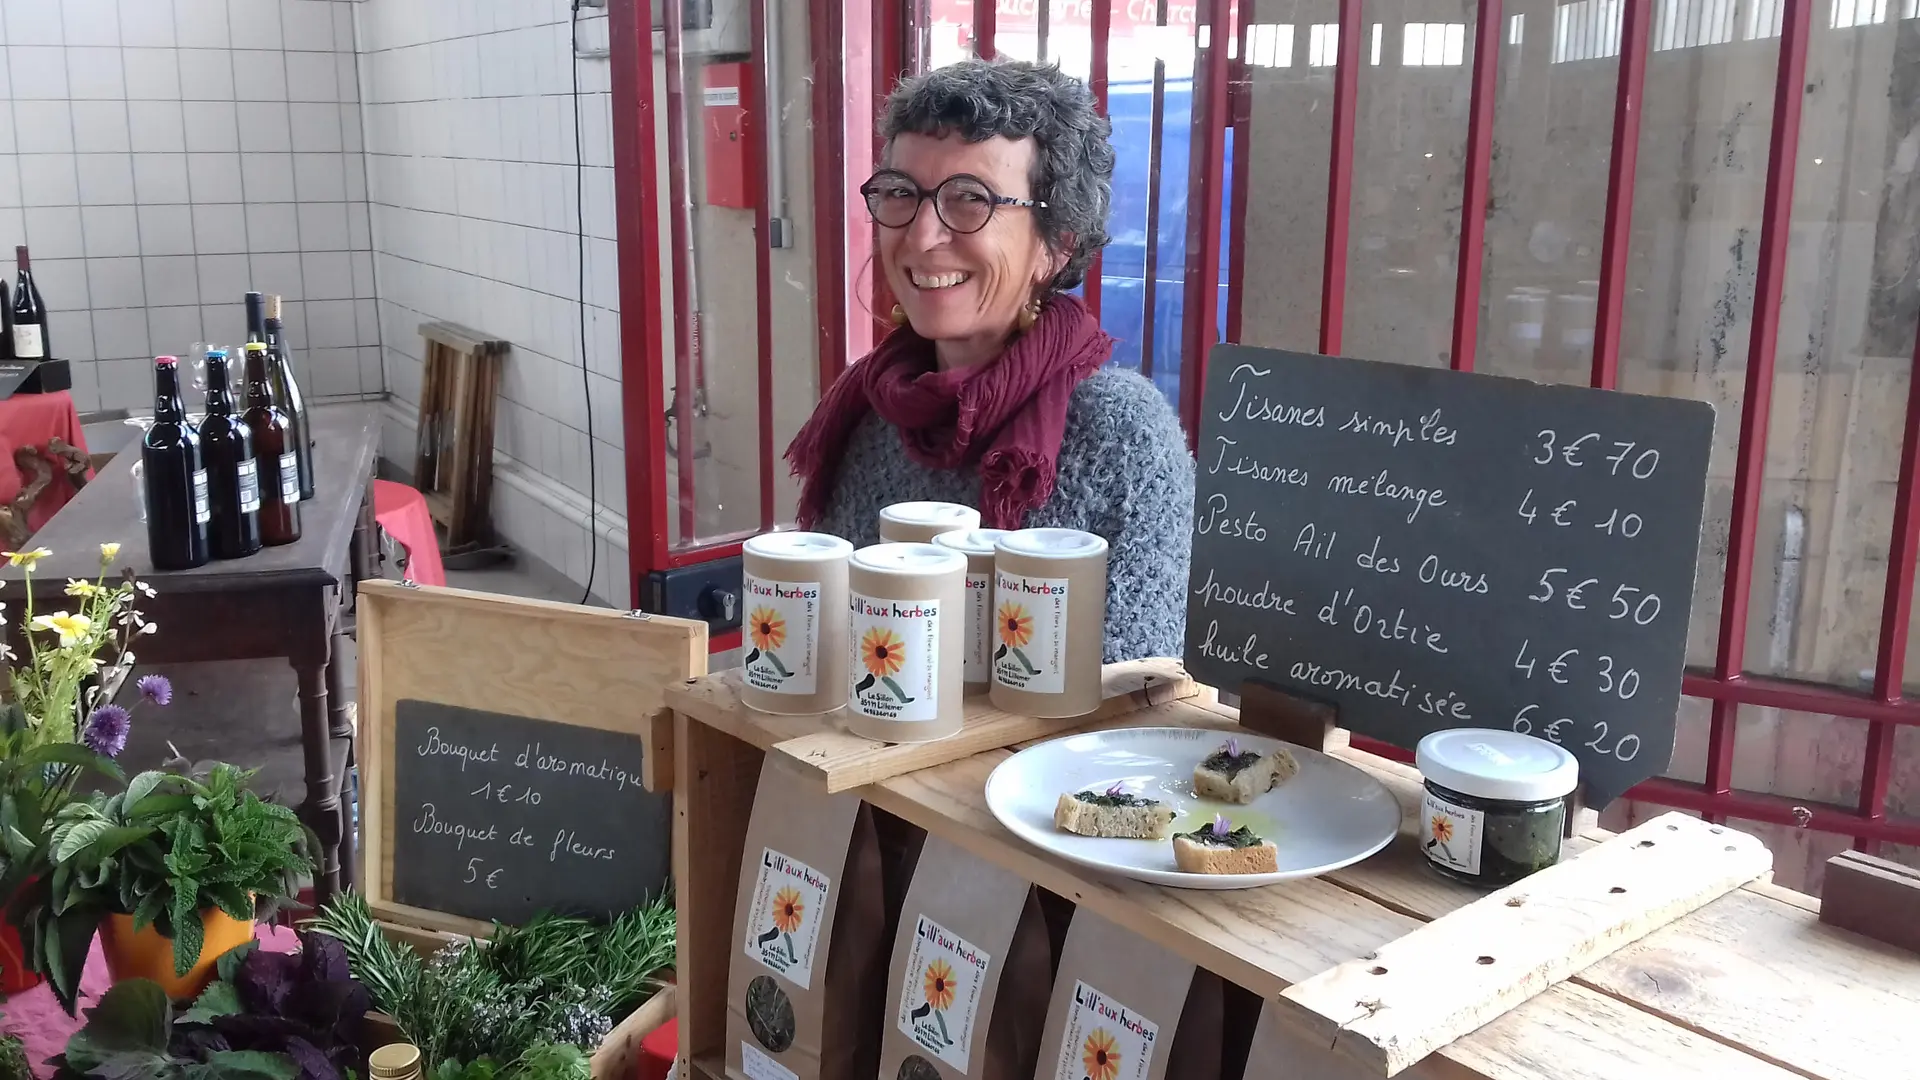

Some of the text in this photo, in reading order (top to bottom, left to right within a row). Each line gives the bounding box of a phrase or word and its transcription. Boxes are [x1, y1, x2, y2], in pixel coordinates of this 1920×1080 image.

[1219, 364, 1324, 427] Tisanes
[1339, 408, 1457, 447] simples
[1209, 435, 1308, 486] Tisanes
[1198, 493, 1267, 542] Pesto
[1293, 523, 1337, 560] Ail
[1357, 536, 1400, 573] des
[1419, 555, 1489, 593] Ours
[775, 584, 817, 599] herbes
[850, 594, 937, 618] Lill'aux herbes
[965, 577, 986, 589] bes
[1022, 579, 1065, 595] herbes
[1195, 569, 1297, 616] poudre
[1198, 619, 1270, 670] huile
[1289, 660, 1472, 720] aromatisée
[418, 726, 642, 791] Bouquet d'aromatiqu
[414, 802, 615, 861] Bouquet de fleurs
[764, 851, 828, 892] Lill'aux herbes
[918, 919, 987, 970] Lill'aux herbes
[1075, 984, 1155, 1042] Lill'aux herbes
